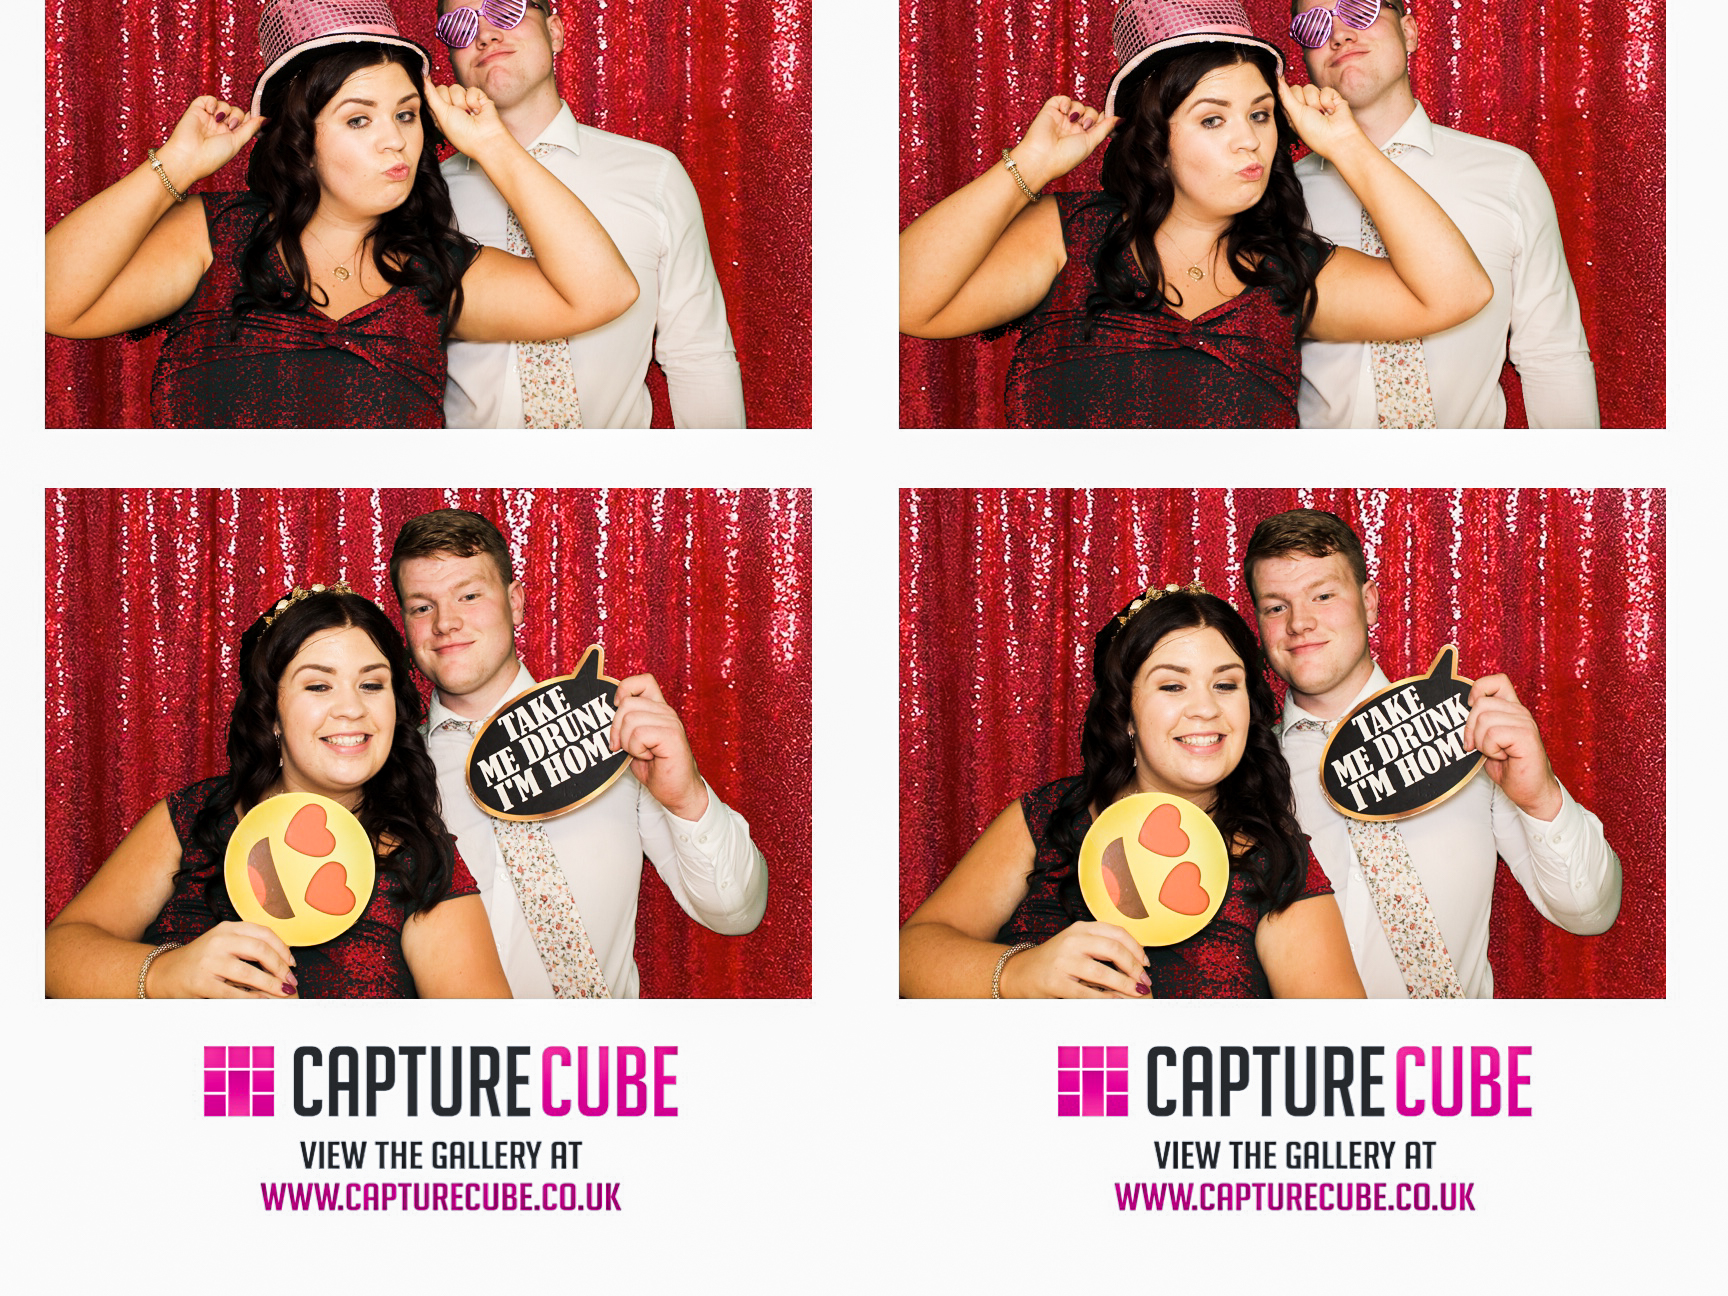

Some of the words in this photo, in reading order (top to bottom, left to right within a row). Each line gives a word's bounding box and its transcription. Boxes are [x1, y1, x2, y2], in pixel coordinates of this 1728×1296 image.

[476, 746, 521, 788] ME
[518, 692, 616, 766] DRUNK
[497, 684, 572, 743] TAKE
[1330, 746, 1375, 788] ME
[1372, 692, 1470, 766] DRUNK
[1351, 684, 1426, 743] TAKE
[493, 767, 543, 812] I'M
[1347, 767, 1397, 812] I'M
